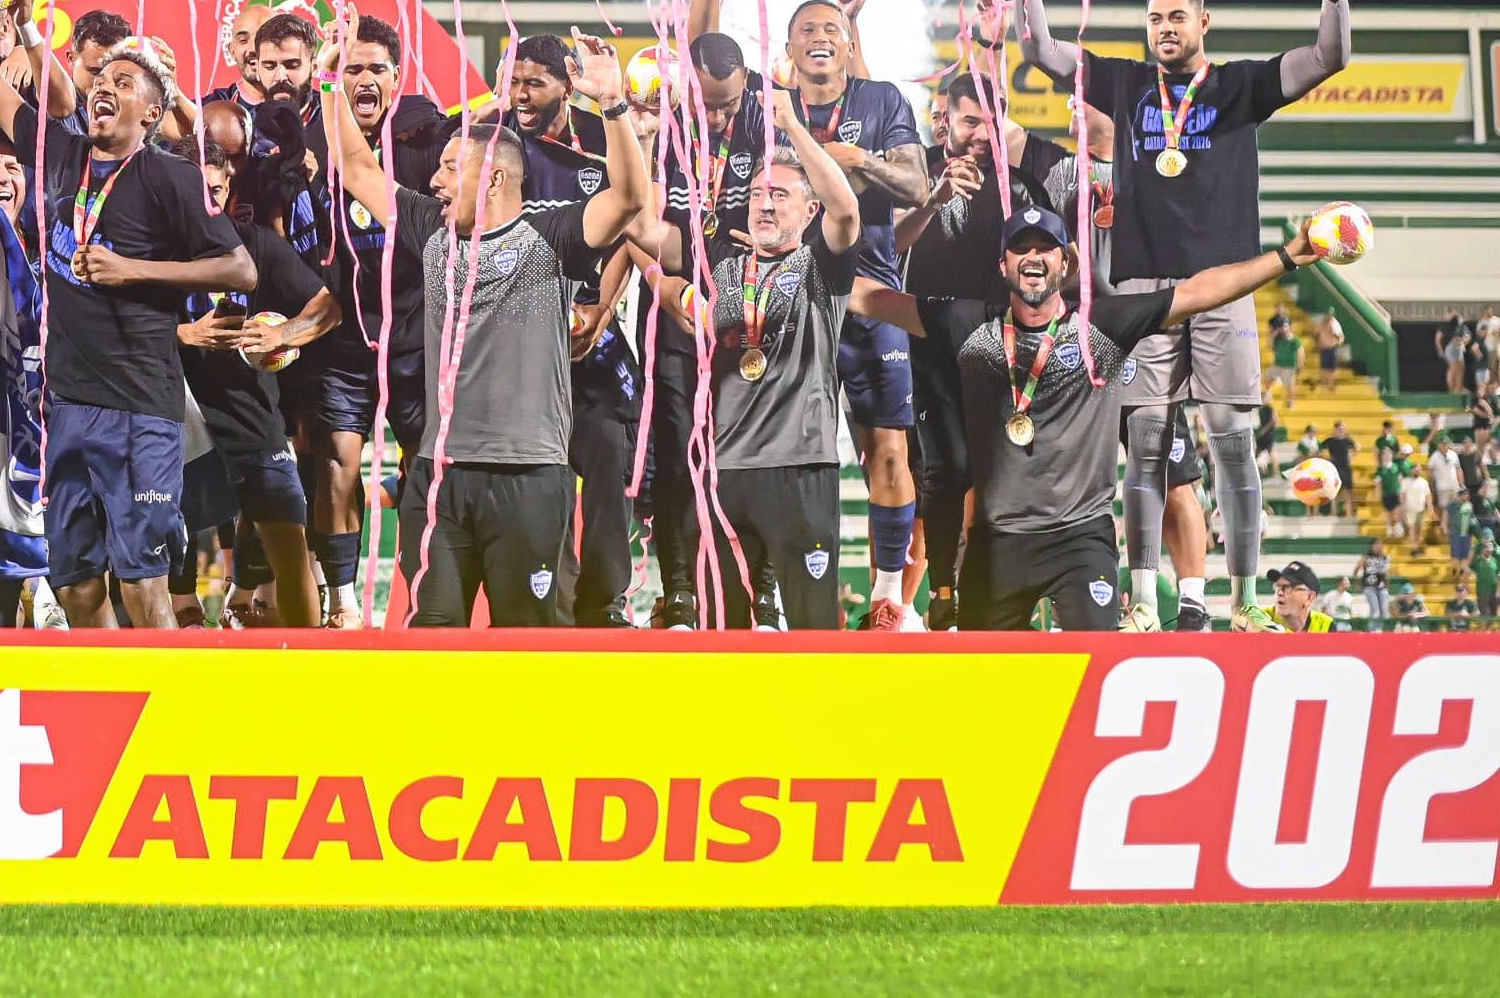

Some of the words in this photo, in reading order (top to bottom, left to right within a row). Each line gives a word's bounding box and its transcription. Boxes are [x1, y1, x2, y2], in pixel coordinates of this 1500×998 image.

[134, 489, 172, 504] unifique
[108, 775, 965, 864] ATACADISTA
[1069, 654, 1500, 891] 202
